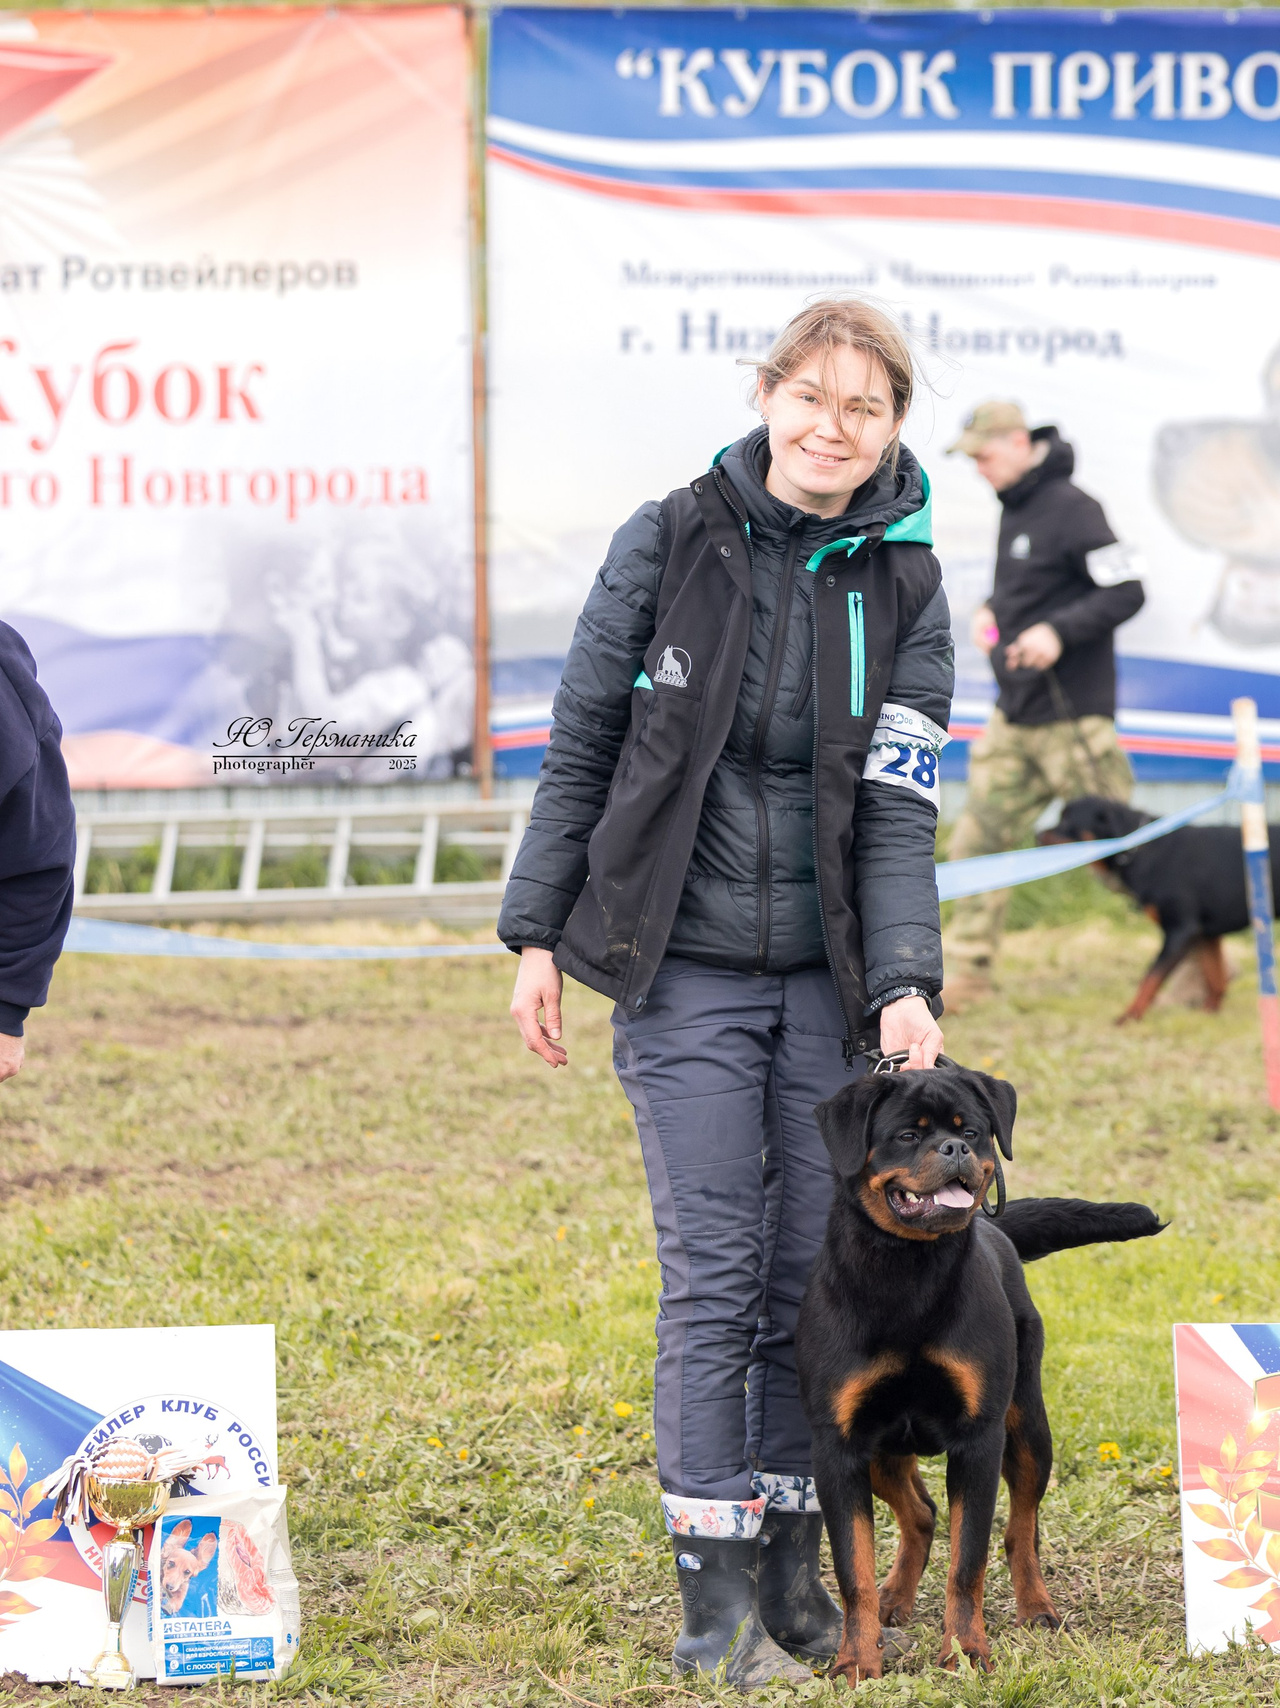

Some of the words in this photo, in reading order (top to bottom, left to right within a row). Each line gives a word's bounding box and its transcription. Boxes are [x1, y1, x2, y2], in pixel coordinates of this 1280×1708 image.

[616, 48, 957, 118] “КУБОК
[62, 255, 358, 294] Ротвейлеров
[89, 454, 431, 523] Новгорода
[880, 742, 937, 789] 28
[81, 1404, 146, 1458] ЕЙЛЕР
[161, 1399, 220, 1421] КЛУБ
